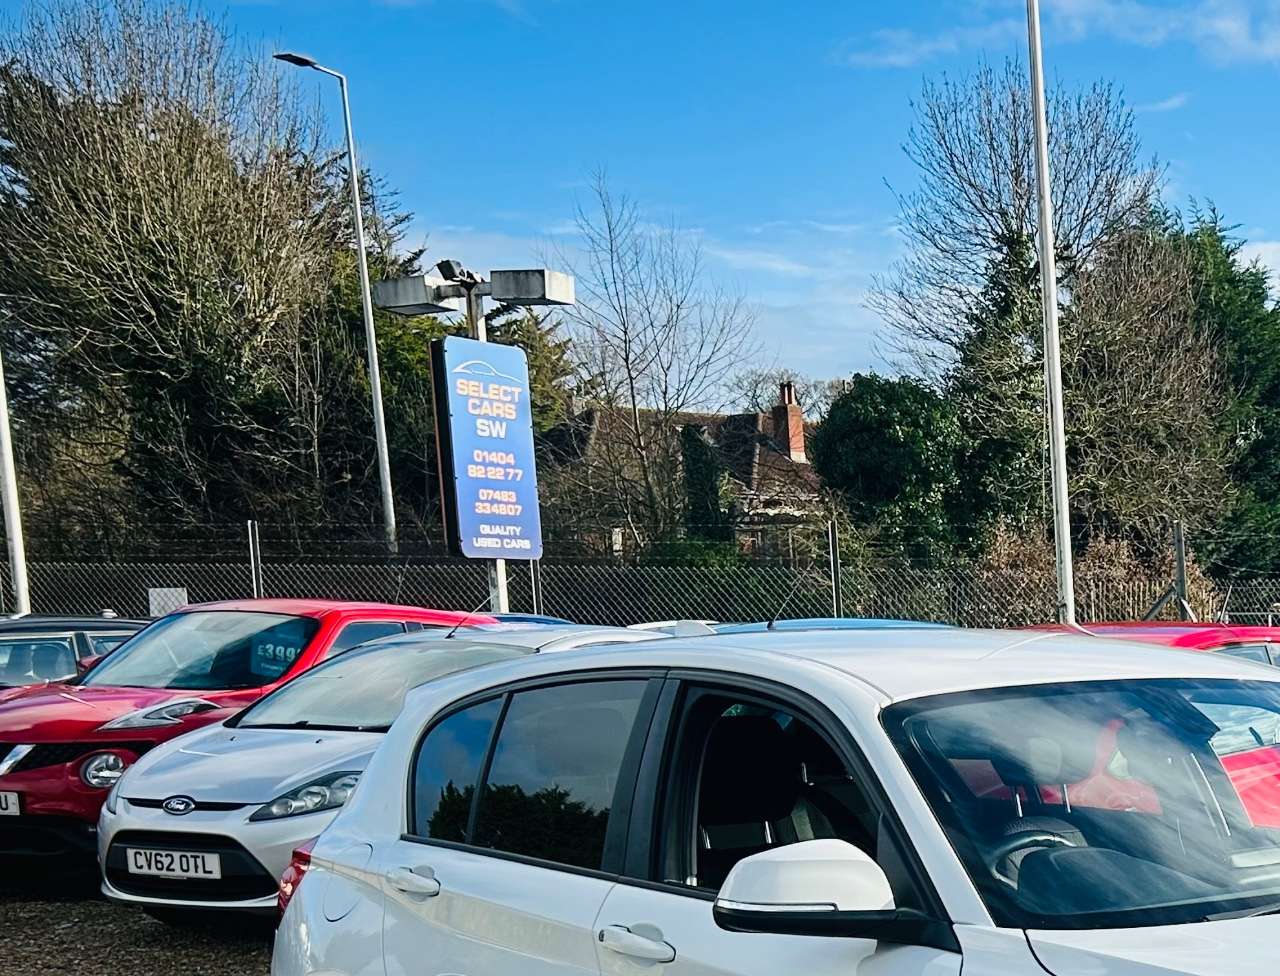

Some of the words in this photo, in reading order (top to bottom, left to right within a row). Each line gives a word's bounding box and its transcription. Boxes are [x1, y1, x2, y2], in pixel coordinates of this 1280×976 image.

[456, 379, 522, 402] SELECT
[468, 398, 516, 420] CARS
[476, 418, 507, 439] SW
[473, 449, 515, 466] 01404
[479, 524, 522, 536] QUALITY
[472, 537, 501, 548] USED
[503, 538, 531, 550] CARS
[257, 643, 301, 662] £399
[133, 850, 176, 873] CV62
[179, 853, 214, 875] OTL
